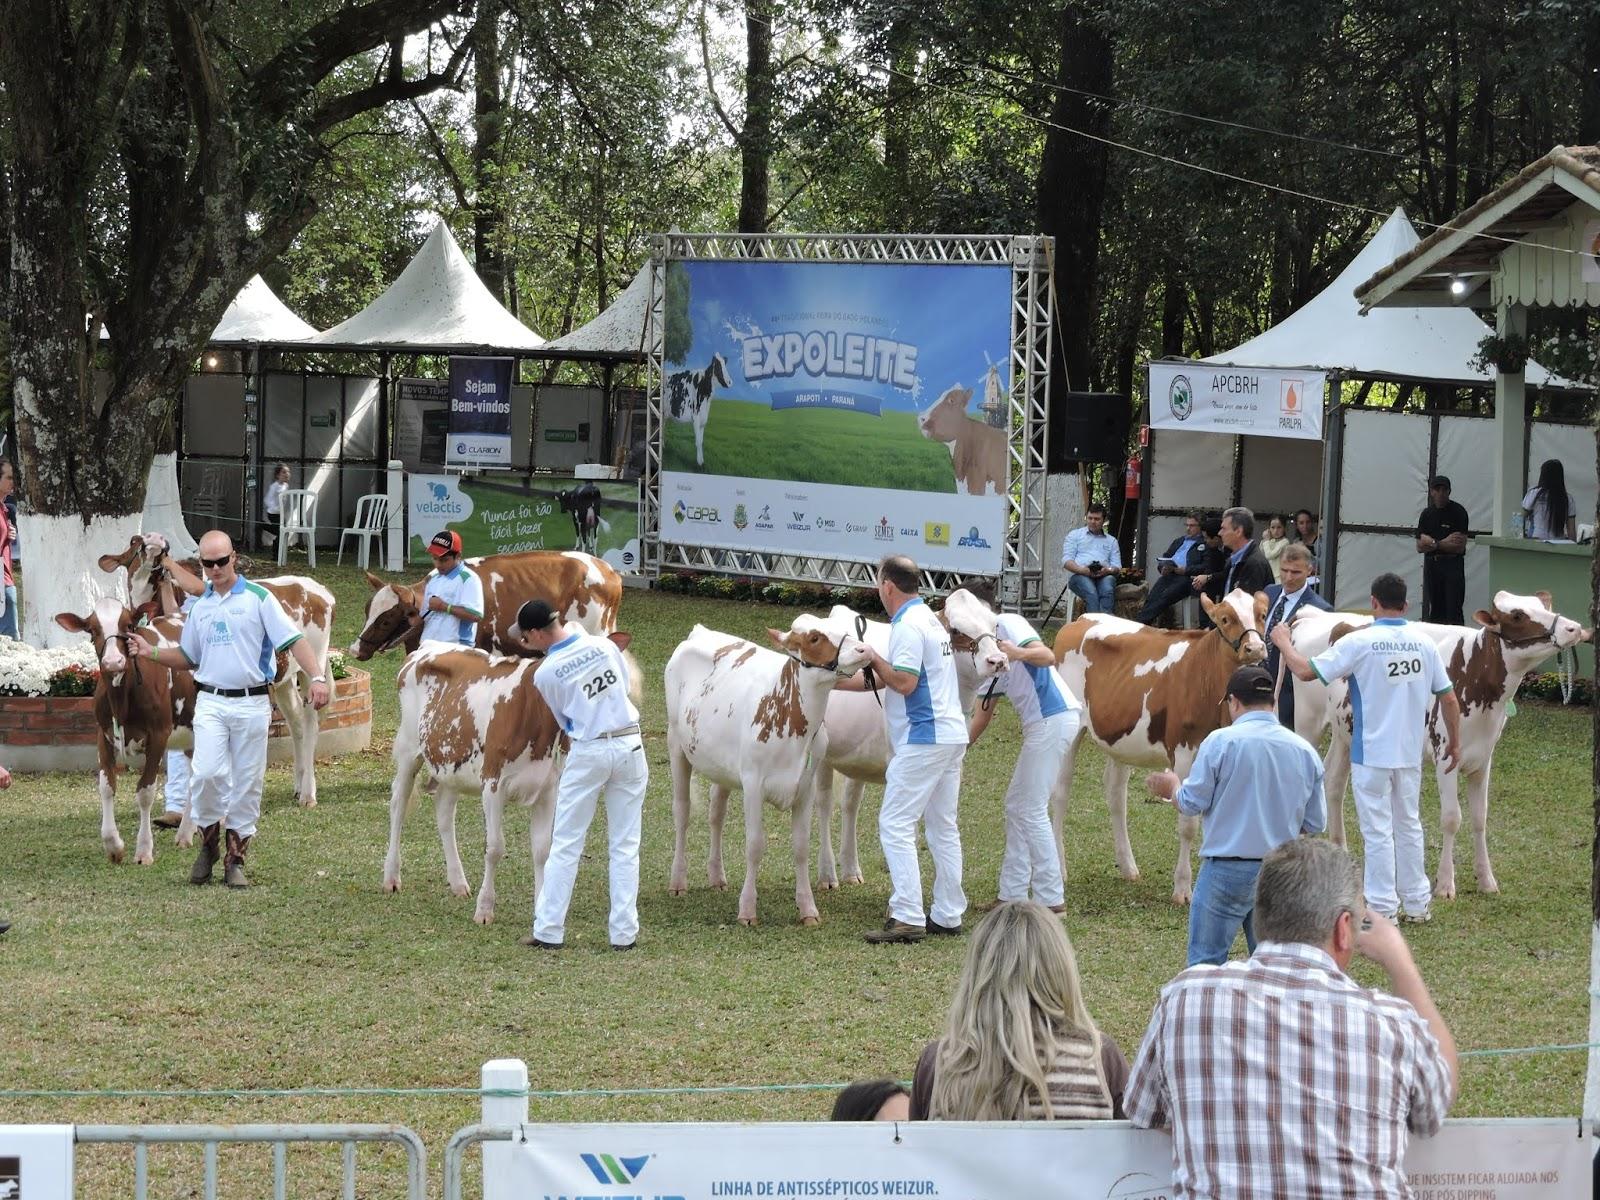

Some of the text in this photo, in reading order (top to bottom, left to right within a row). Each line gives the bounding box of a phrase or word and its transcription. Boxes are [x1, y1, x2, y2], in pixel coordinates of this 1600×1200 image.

[742, 330, 918, 390] EXPOLEITE
[465, 379, 497, 396] Sejam
[1211, 374, 1260, 395] APCBRH
[451, 398, 511, 414] Bem-vindos
[795, 394, 821, 404] ARAPOTI
[468, 446, 502, 454] CLARION
[416, 500, 462, 514] velactis
[480, 501, 553, 525] Nunca foi tão
[489, 521, 543, 541] fácil fazer
[874, 525, 895, 539] SEMEX
[900, 528, 919, 537] CAIXA
[957, 536, 989, 549] BRASIL
[1387, 658, 1422, 678] 230
[583, 669, 617, 700] 228
[1422, 1172, 1466, 1186] INSISTEM
[1468, 1172, 1495, 1185] FICAR
[1497, 1171, 1538, 1185] ALOJADA
[1540, 1170, 1559, 1184] NOS
[711, 1178, 940, 1196] LINHA DE ANTISSÉPTICOS WEIZUR.
[1457, 1189, 1497, 1200] DIPPING
